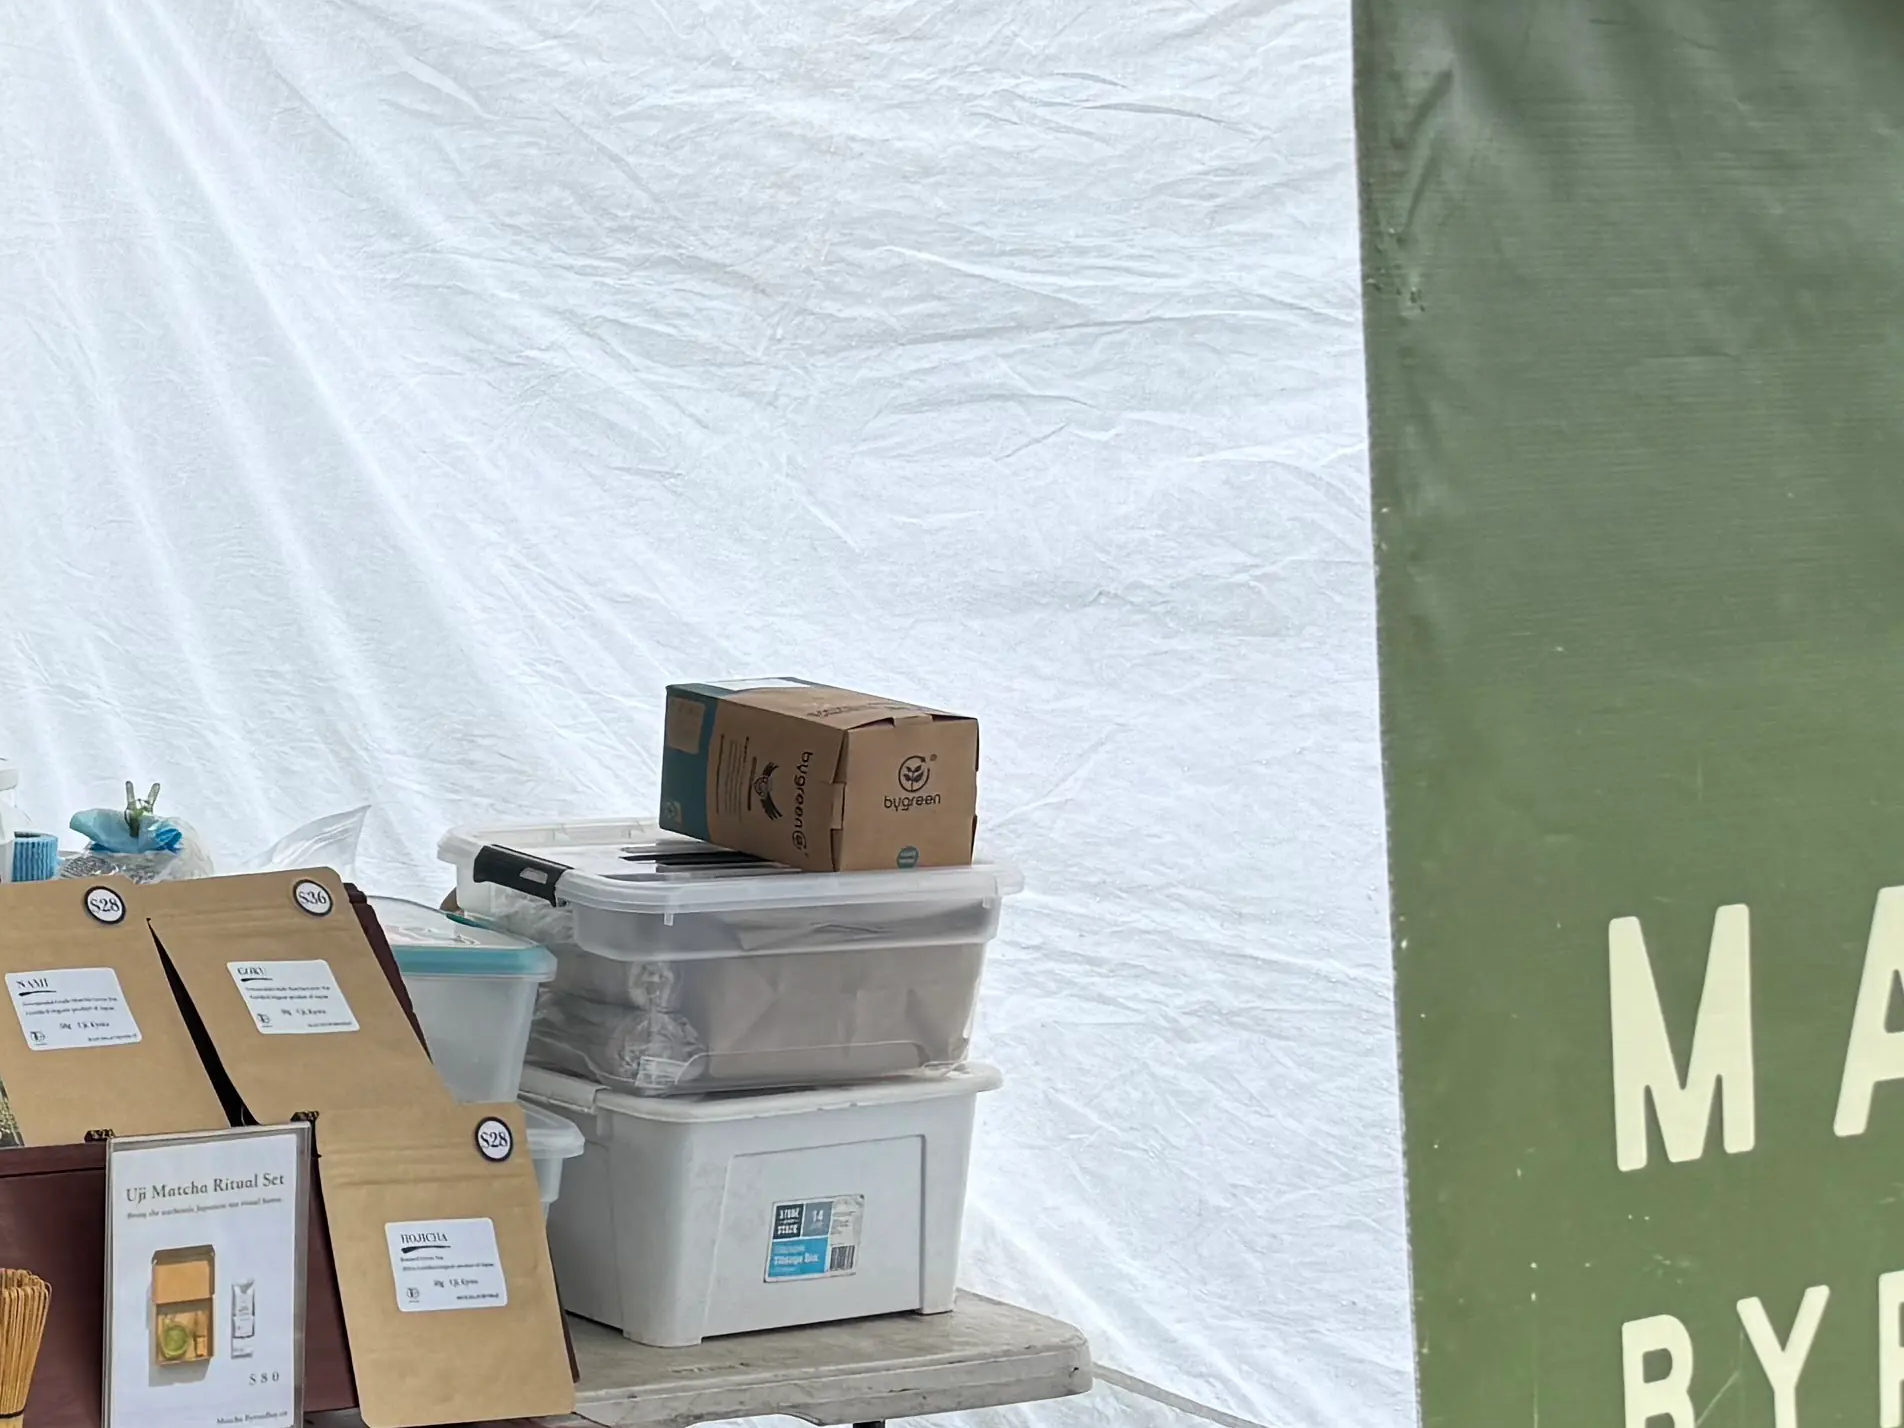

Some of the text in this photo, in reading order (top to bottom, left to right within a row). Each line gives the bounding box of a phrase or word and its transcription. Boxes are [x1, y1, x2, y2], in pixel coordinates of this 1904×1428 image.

[884, 793, 942, 812] bygreen
[126, 1172, 285, 1204] Uji Matcha Ritual Set
